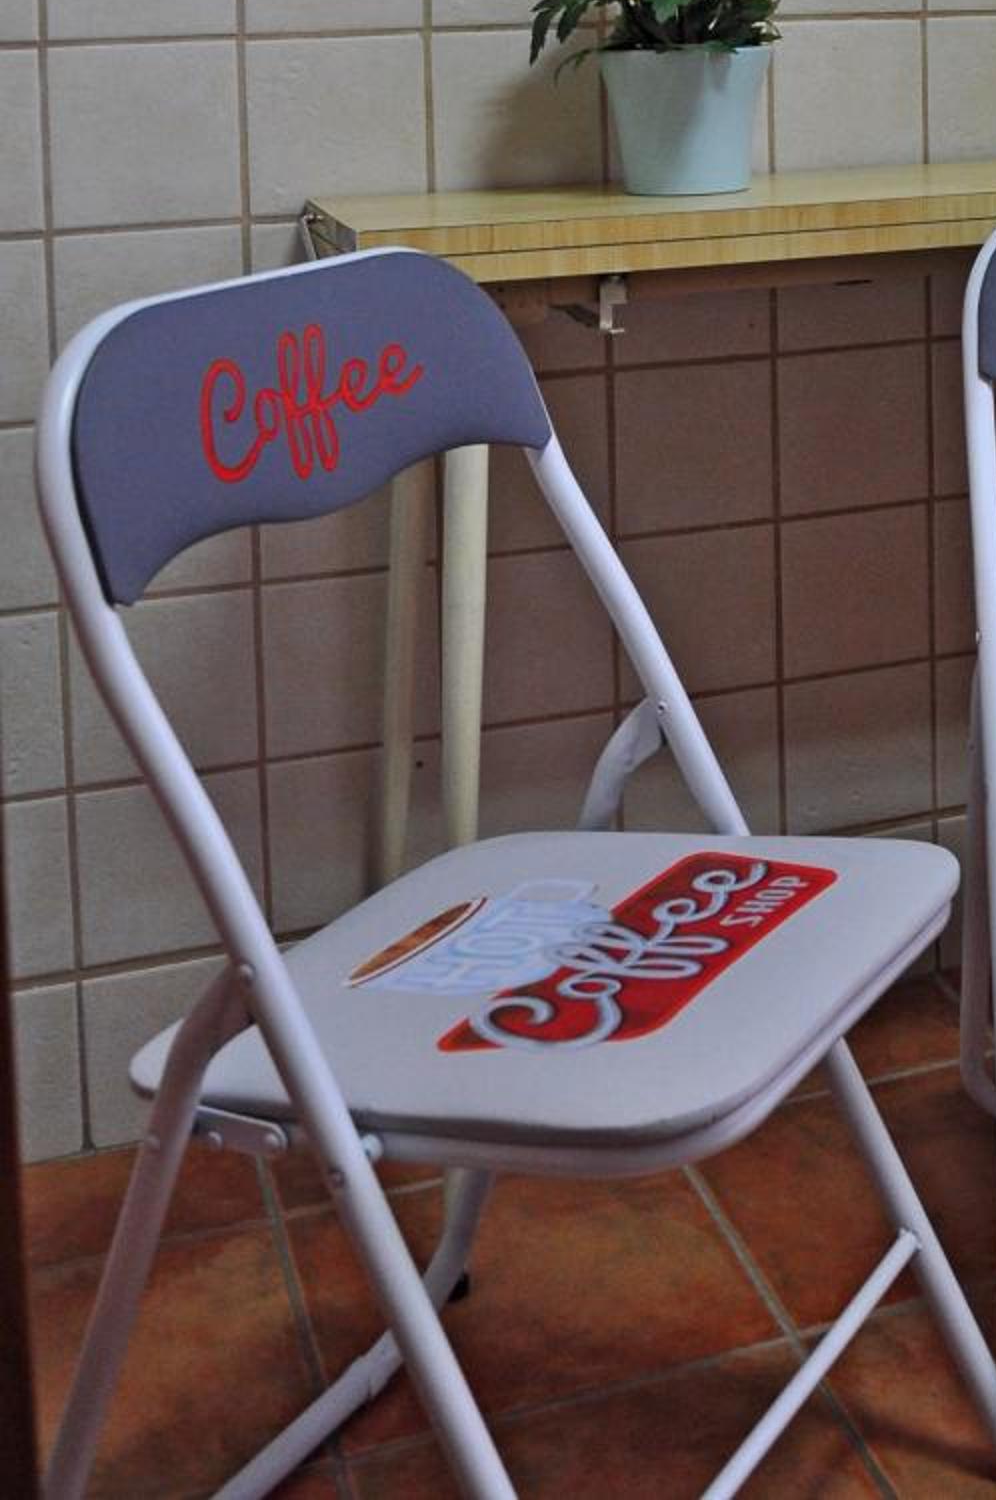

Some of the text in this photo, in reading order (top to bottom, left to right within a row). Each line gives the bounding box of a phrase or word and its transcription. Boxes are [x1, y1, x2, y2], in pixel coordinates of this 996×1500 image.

[199, 324, 424, 484] Coffee
[470, 860, 767, 1048] Coffee
[719, 876, 810, 927] SHOP
